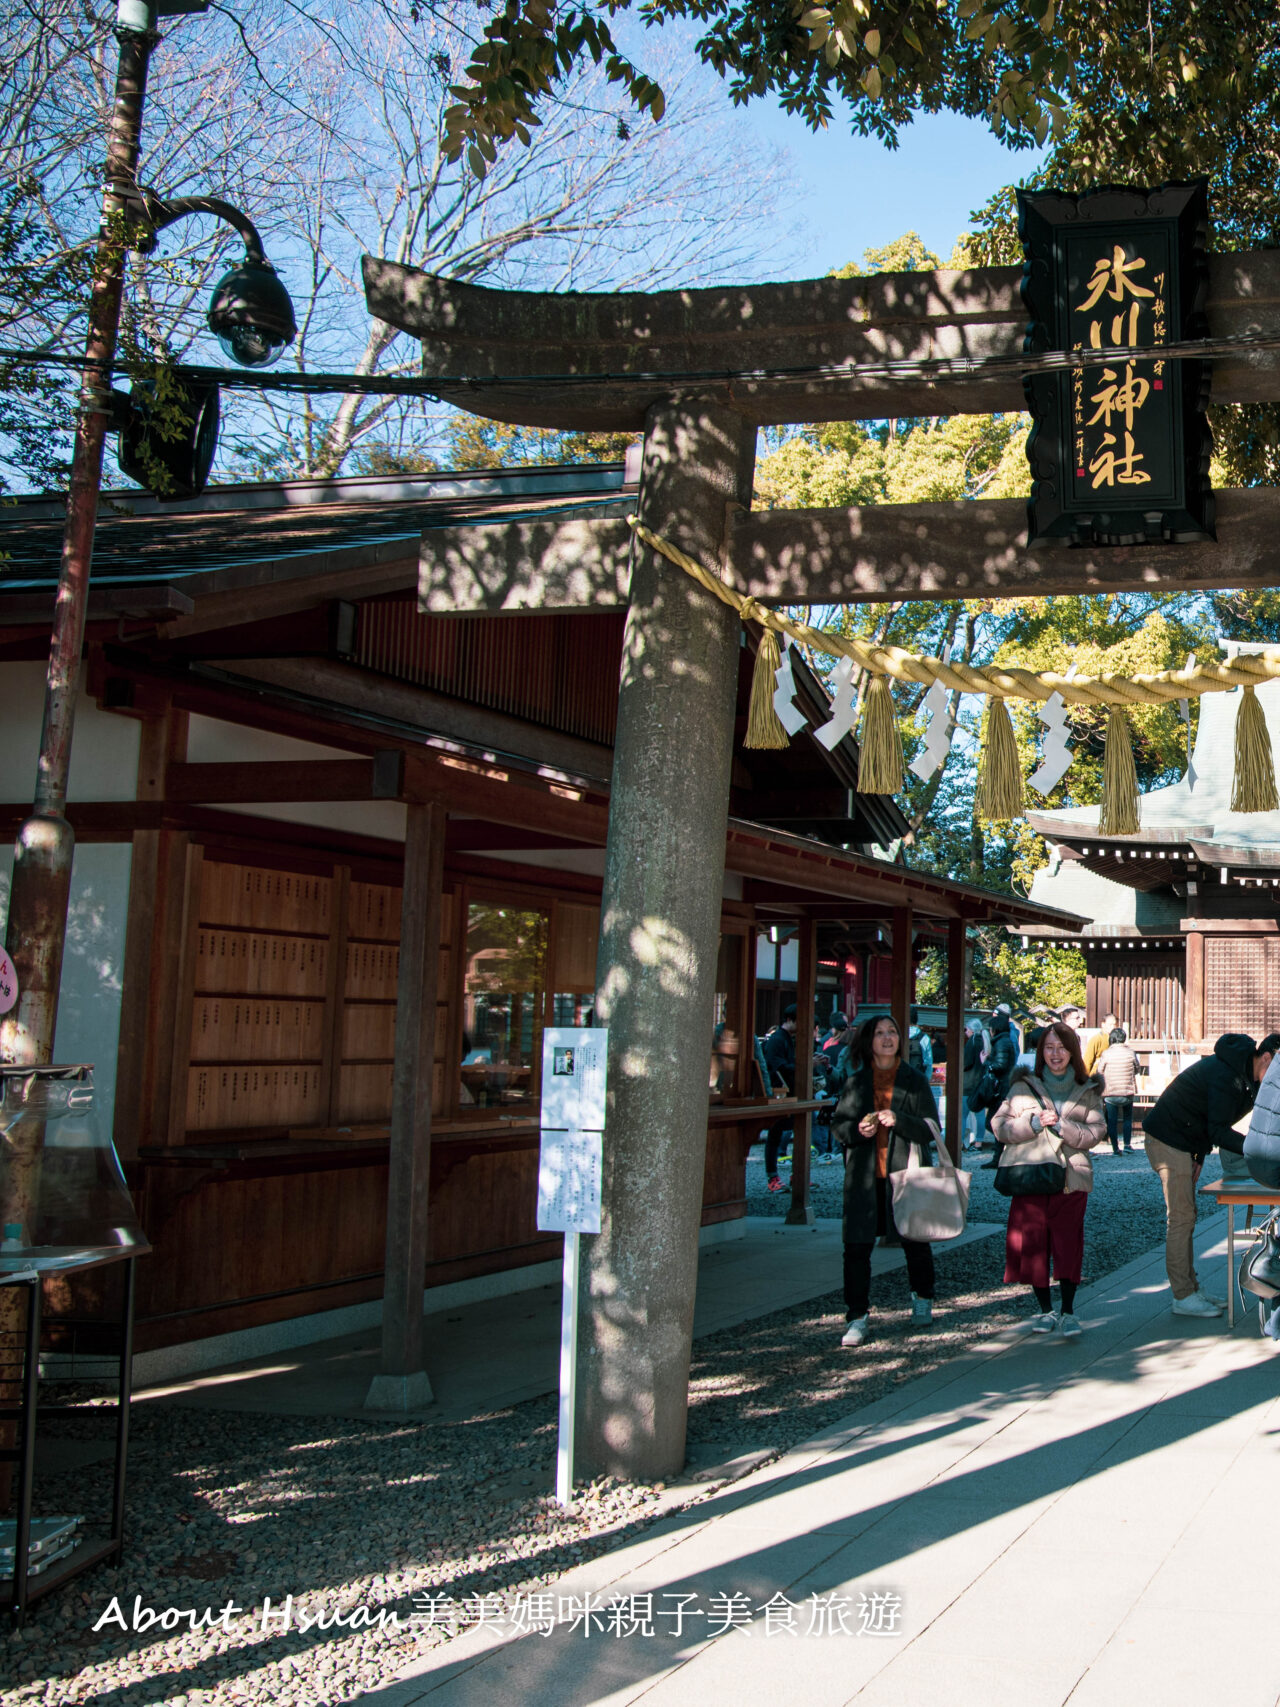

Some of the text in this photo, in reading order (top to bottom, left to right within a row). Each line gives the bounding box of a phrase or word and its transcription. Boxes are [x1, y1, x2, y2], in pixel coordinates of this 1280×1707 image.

[1075, 245, 1155, 489] 氷川神社
[1152, 272, 1166, 377] 川越総守
